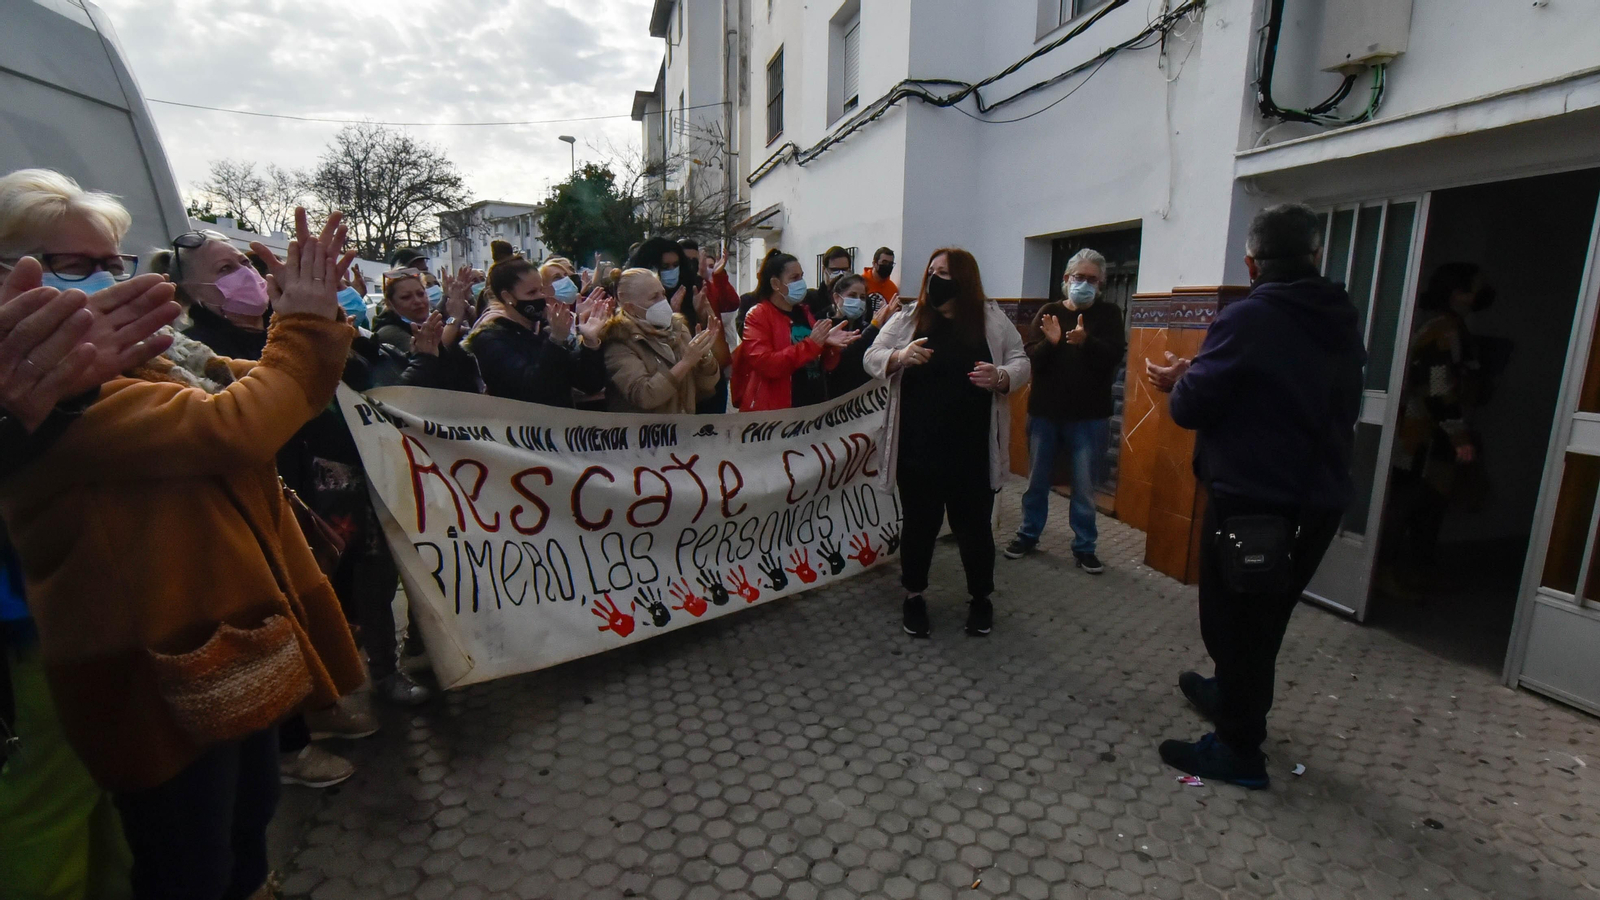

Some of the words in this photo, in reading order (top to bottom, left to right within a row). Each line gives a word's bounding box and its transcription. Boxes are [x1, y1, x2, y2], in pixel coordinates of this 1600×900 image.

[565, 425, 629, 453] VIVIENDA
[638, 423, 678, 449] DIGNA
[741, 421, 783, 444] PAH
[841, 483, 880, 533] NO
